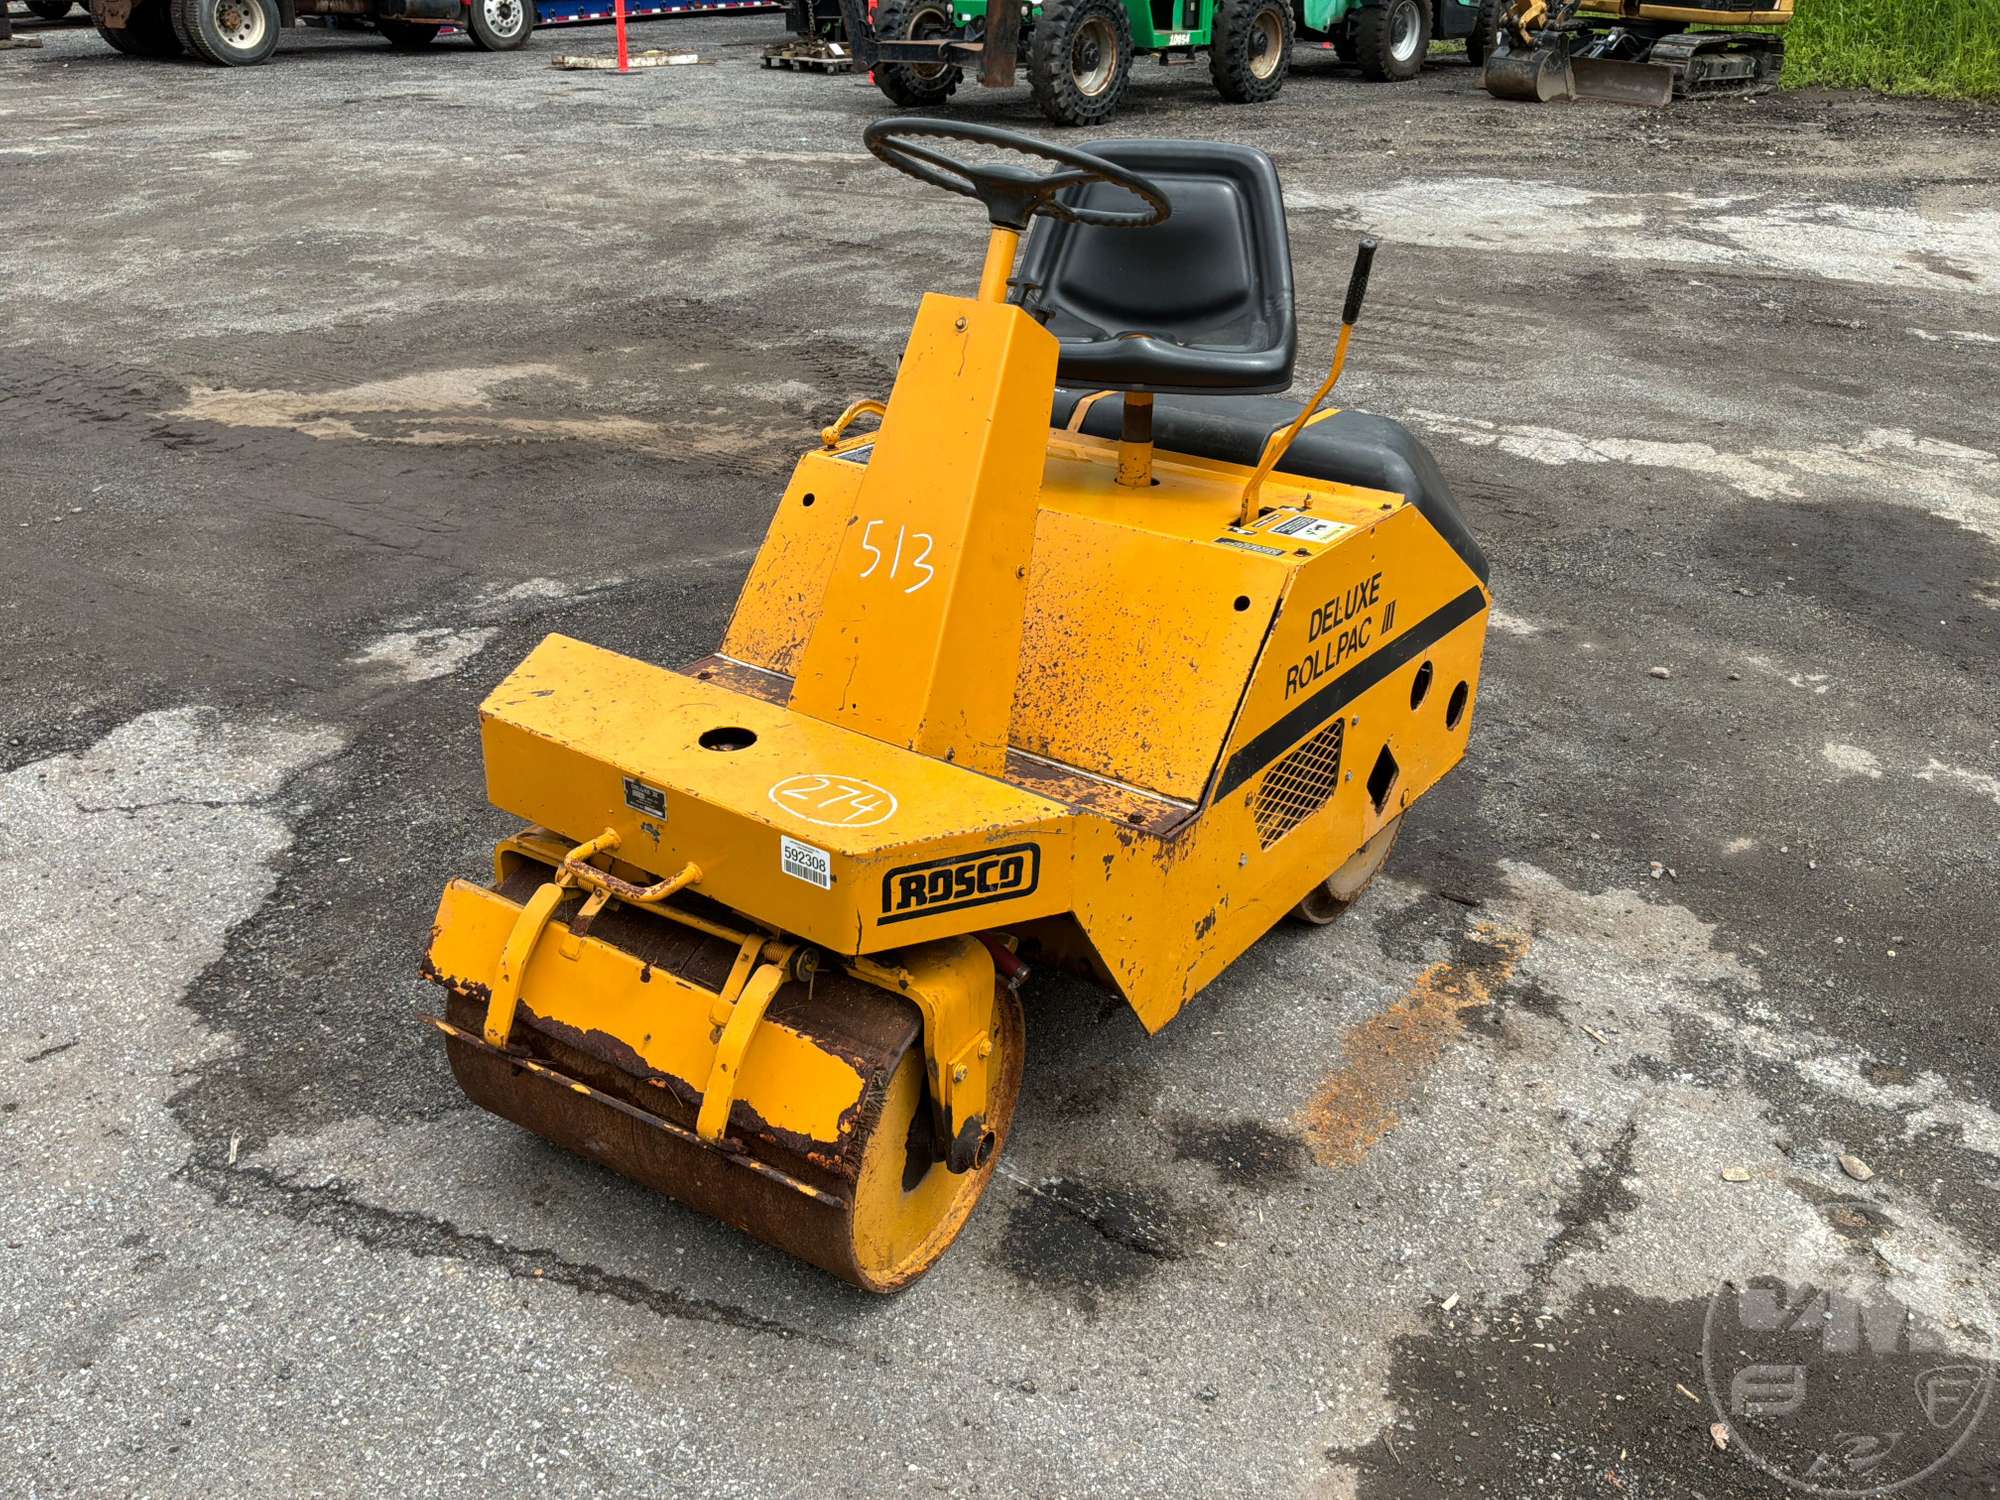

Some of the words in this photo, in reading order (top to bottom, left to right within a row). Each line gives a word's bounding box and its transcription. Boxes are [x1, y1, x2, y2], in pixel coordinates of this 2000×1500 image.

[859, 518, 935, 594] 513
[1308, 572, 1383, 643] DELUXE
[1284, 616, 1372, 700] ROLLPAC
[781, 777, 885, 822] 274
[784, 845, 826, 873] 592308
[896, 856, 1024, 910] ROSCO
